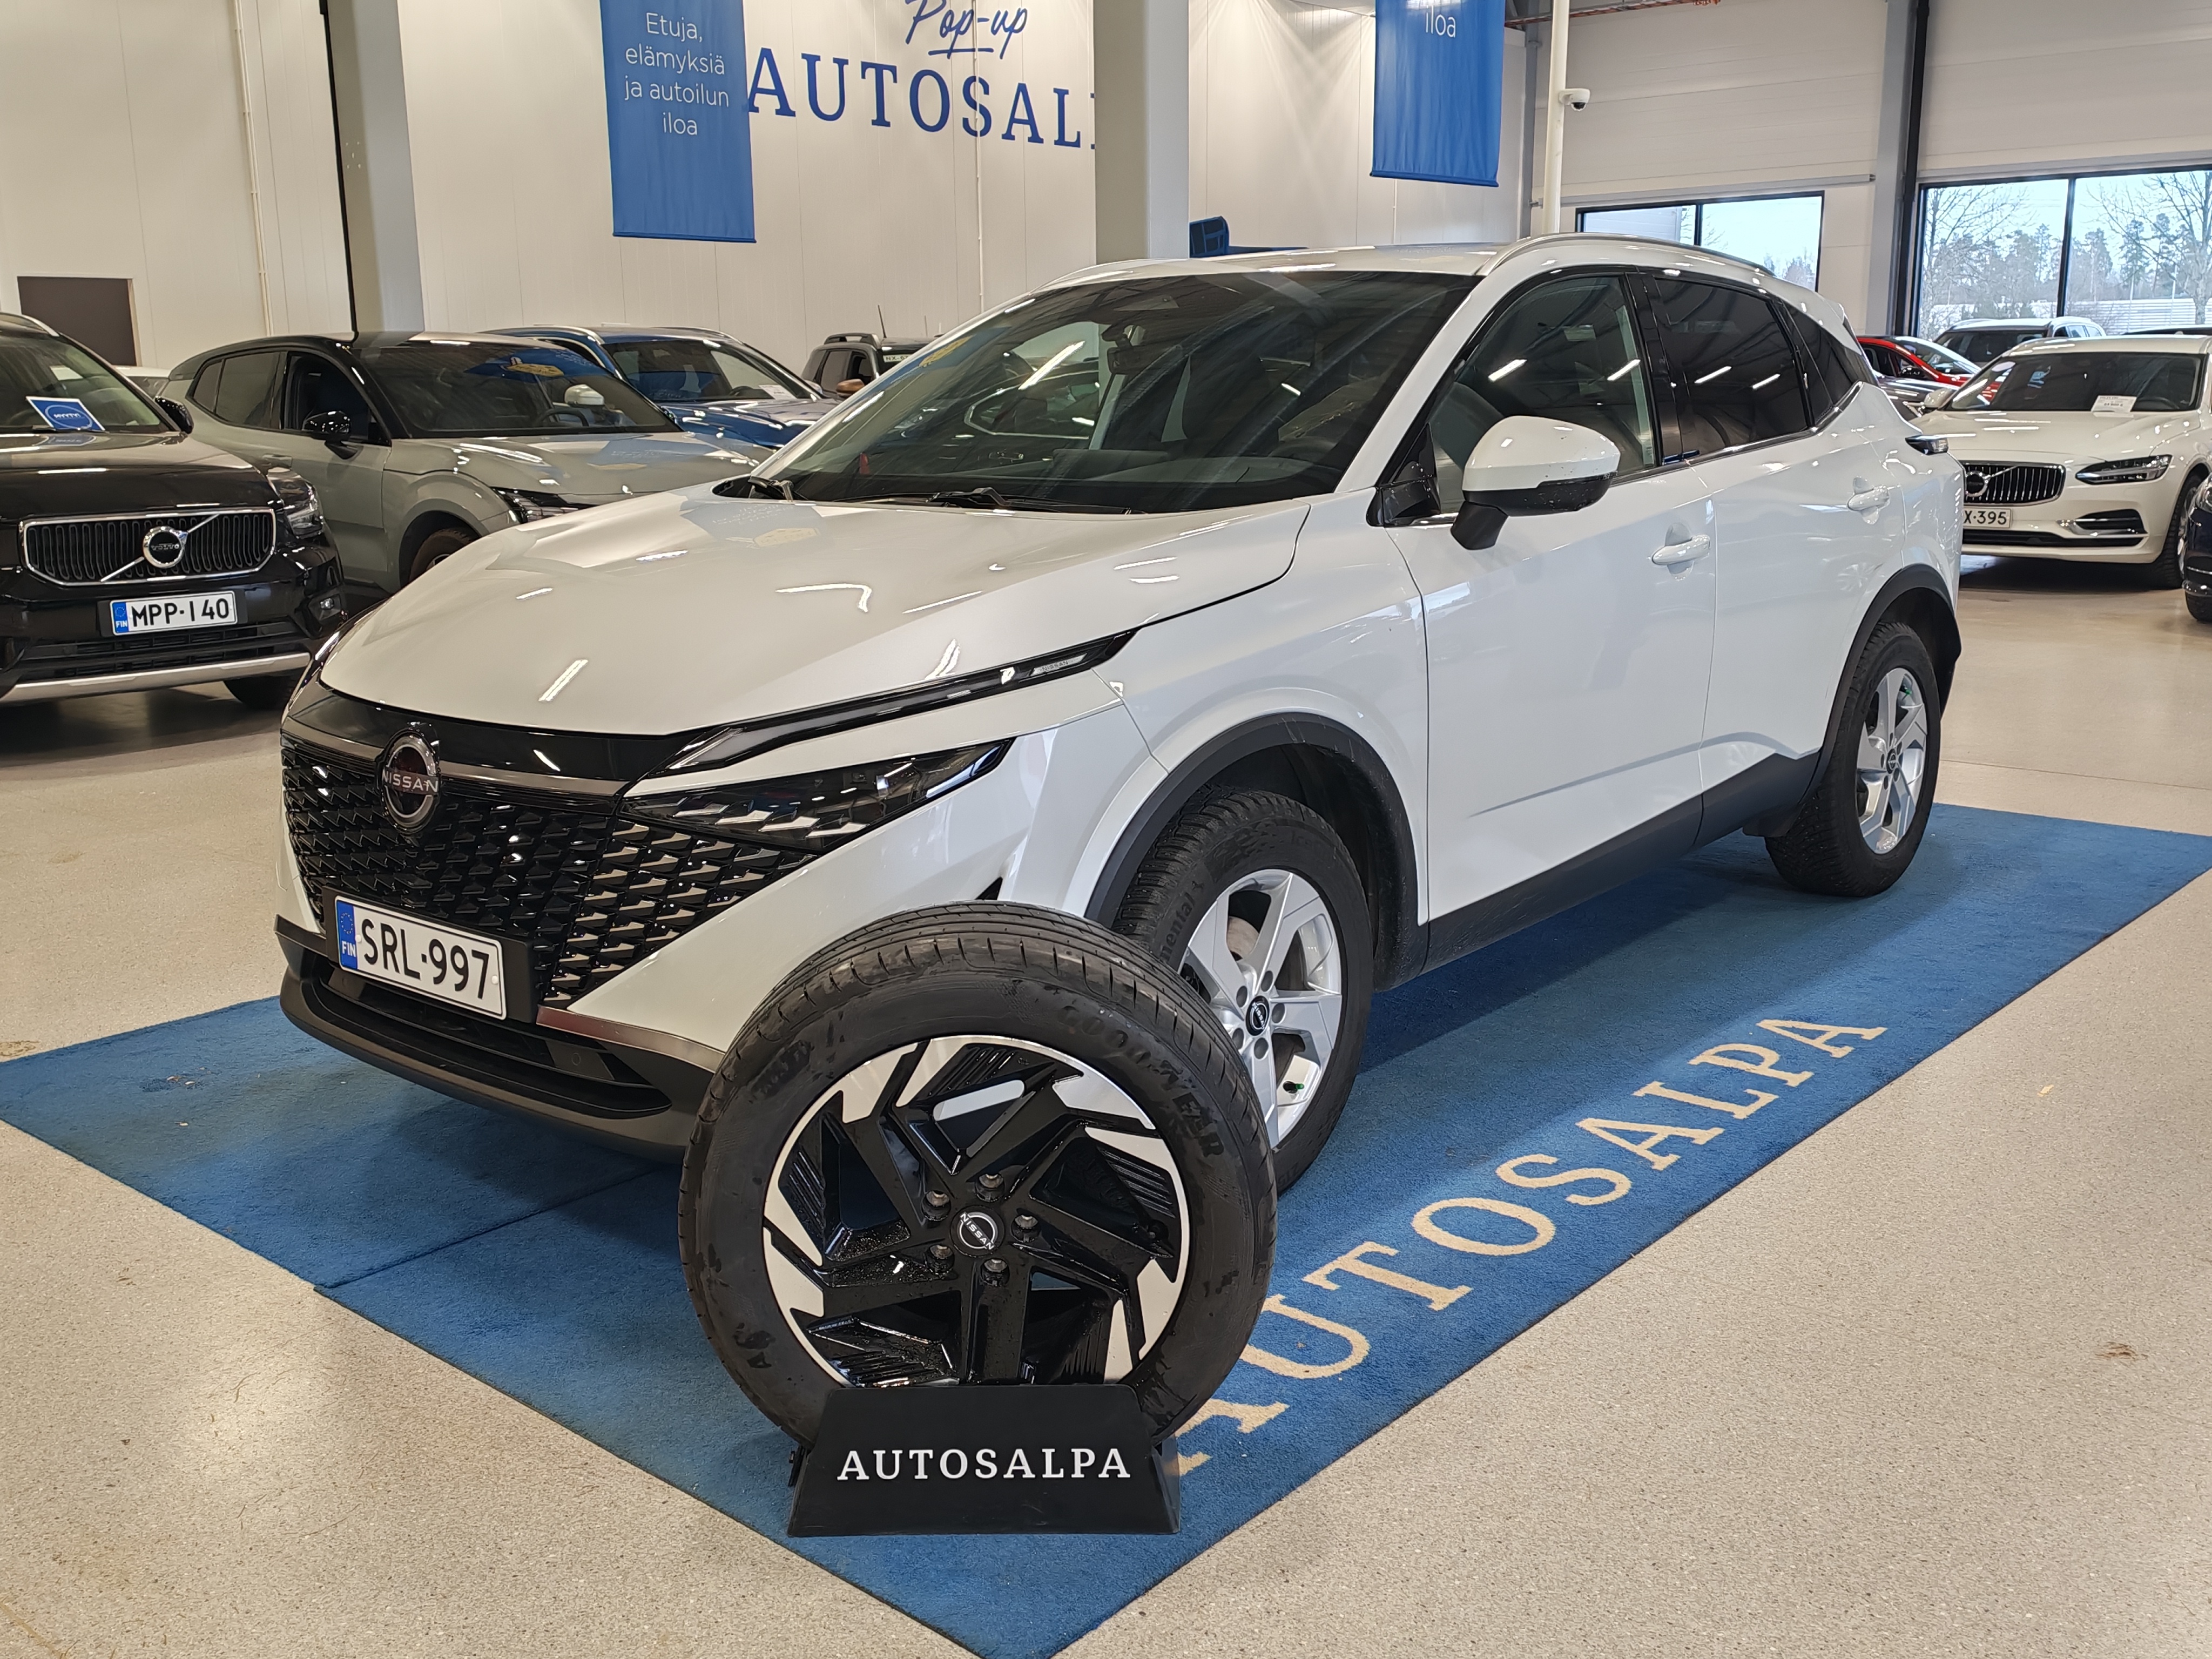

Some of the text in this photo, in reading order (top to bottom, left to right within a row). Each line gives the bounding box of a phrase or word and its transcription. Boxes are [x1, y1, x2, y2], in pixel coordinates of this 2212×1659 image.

[646, 12, 703, 42] Etuja,
[905, 0, 1028, 59] Pop-up
[1426, 5, 1456, 38] iloa
[625, 43, 725, 75] elämyksiä
[624, 75, 729, 107] ja autoilun
[748, 46, 1095, 150] AUTOSAL
[663, 112, 698, 135] iloa
[116, 598, 229, 628] FIN MPP-140
[1042, 660, 1069, 671] NISSAN
[382, 767, 439, 792] NISSAN
[341, 918, 490, 999] FIN SRL-997
[960, 1212, 995, 1250] NISSAN
[837, 1448, 1130, 1480] AUTOSALPA
